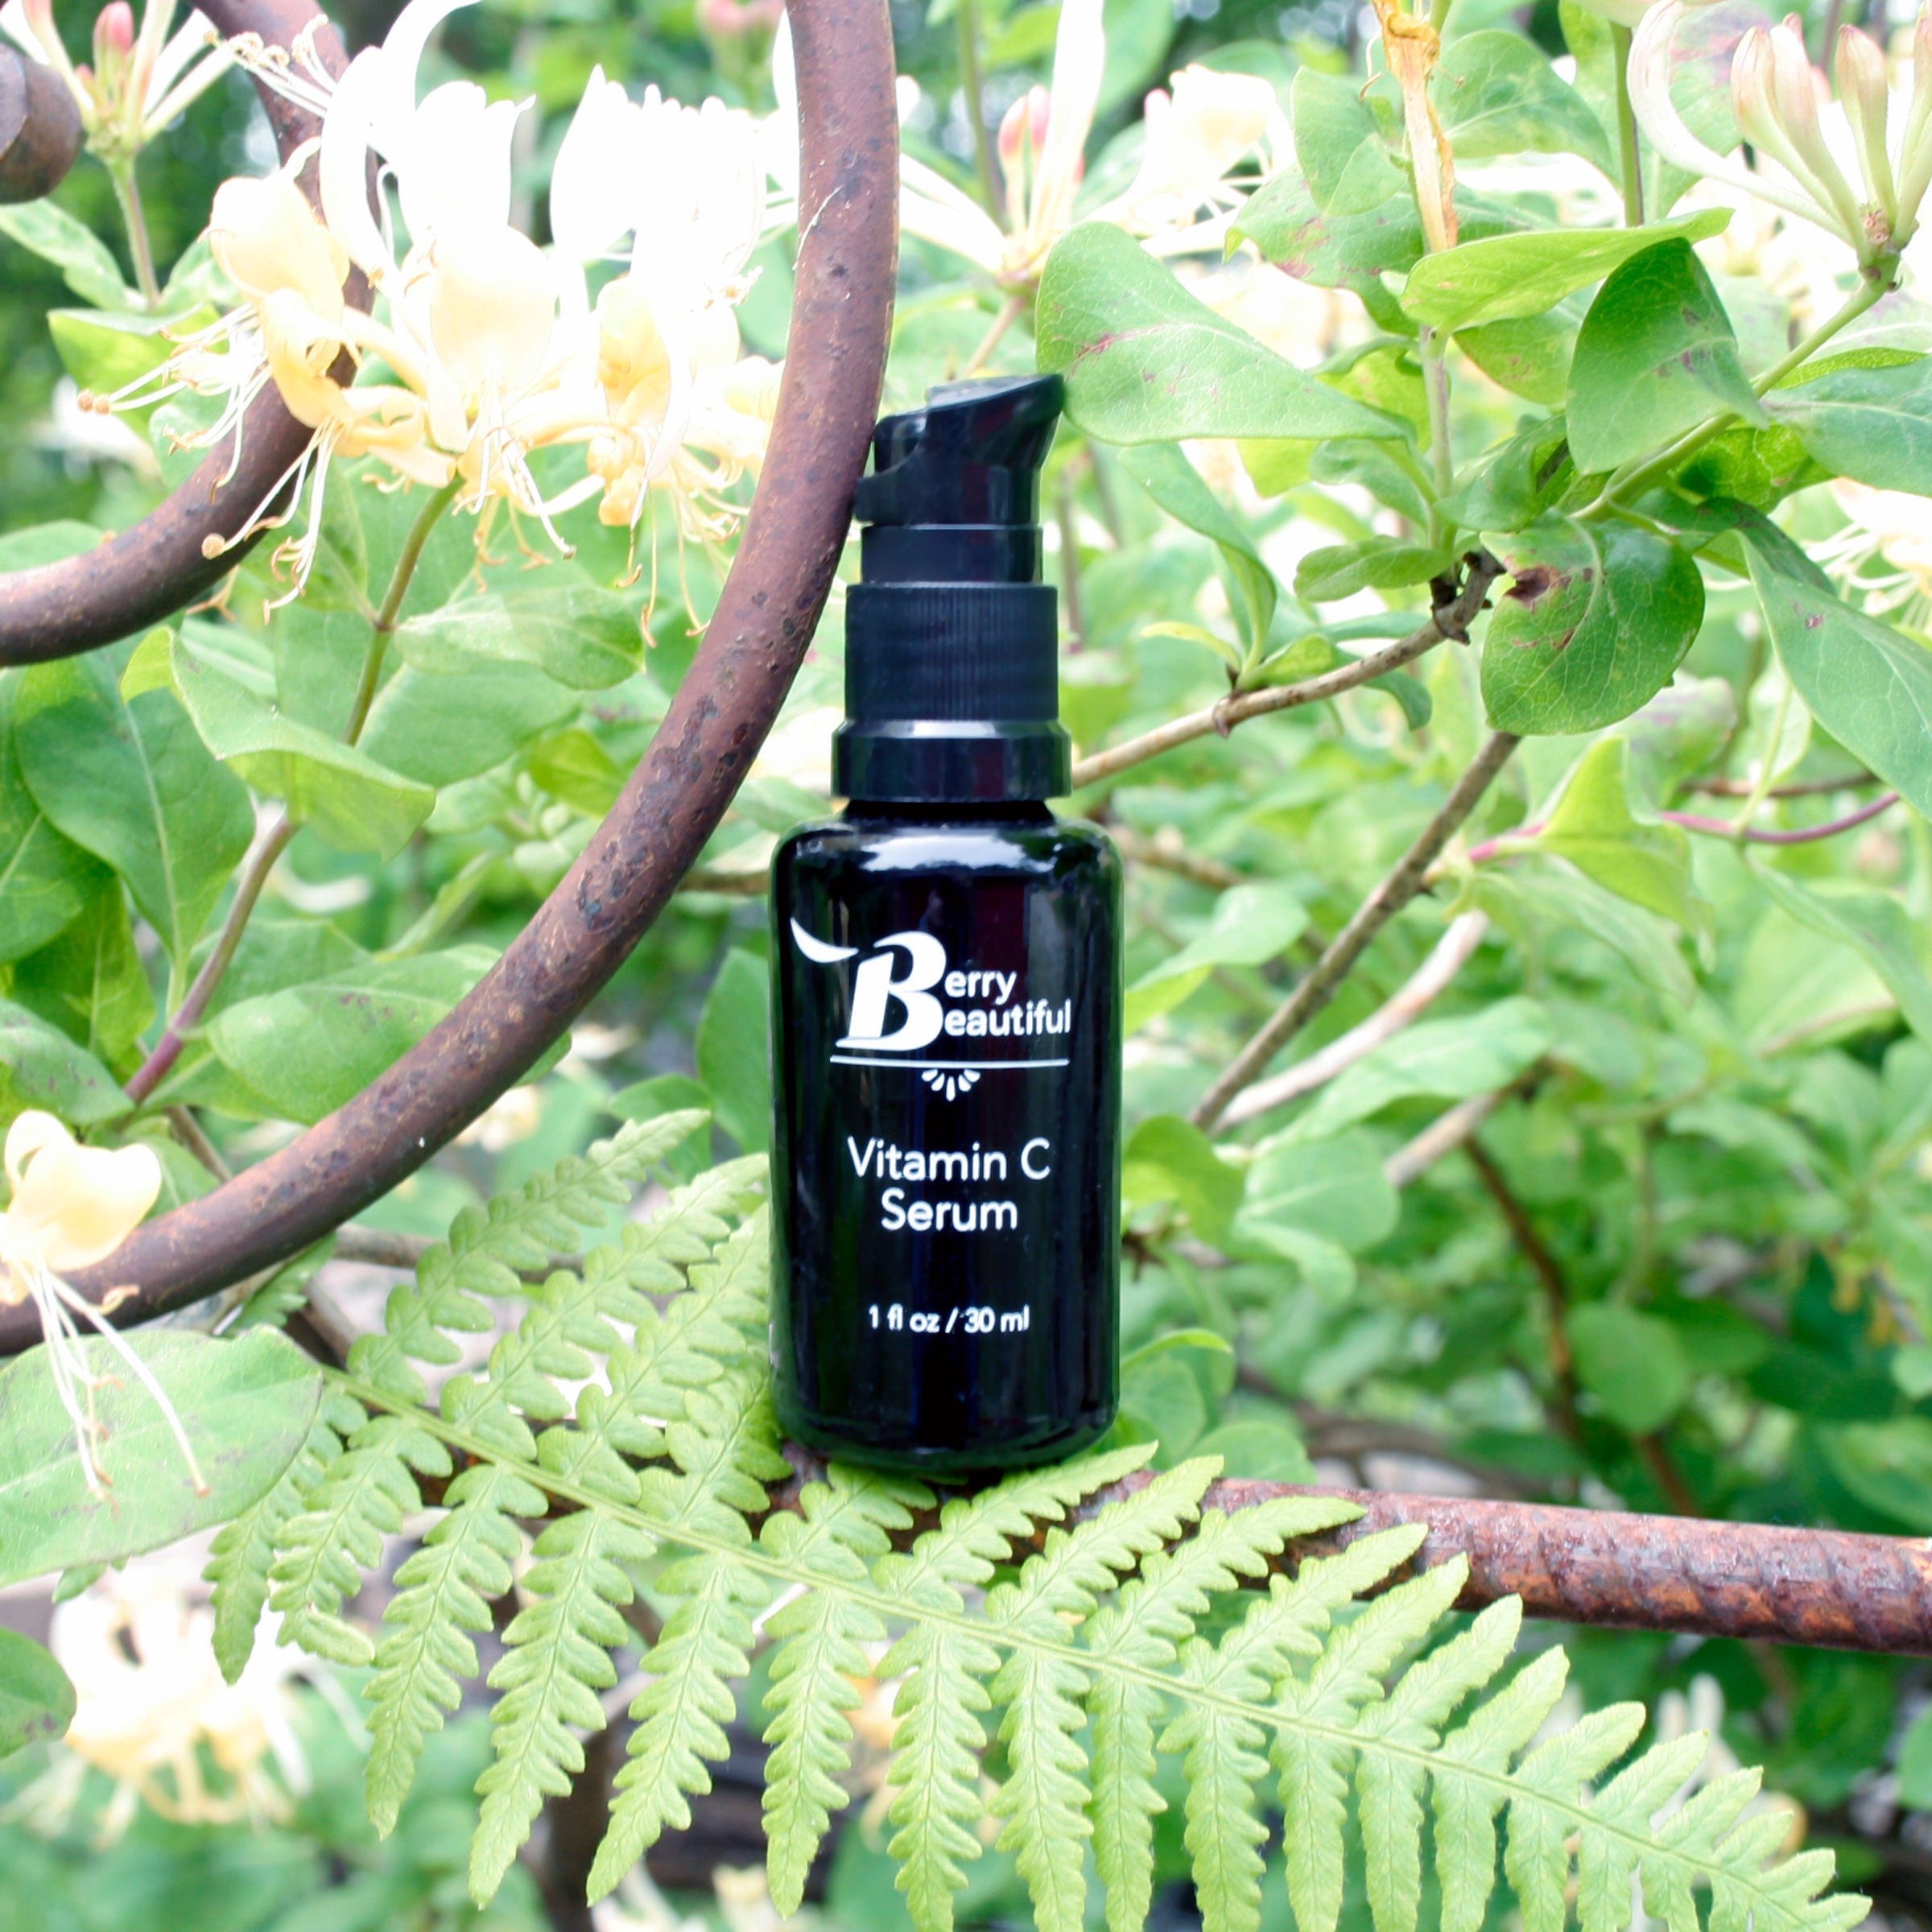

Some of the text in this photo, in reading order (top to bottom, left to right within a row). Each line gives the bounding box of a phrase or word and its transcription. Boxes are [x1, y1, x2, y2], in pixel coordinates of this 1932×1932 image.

[847, 1135, 1051, 1181] Vitamin C
[881, 1187, 1018, 1232] Serum
[869, 1304, 879, 1329] 1
[886, 1302, 903, 1331] fl
[909, 1312, 940, 1333] oz
[964, 1306, 996, 1334] 30
[1000, 1303, 1030, 1333] ml
